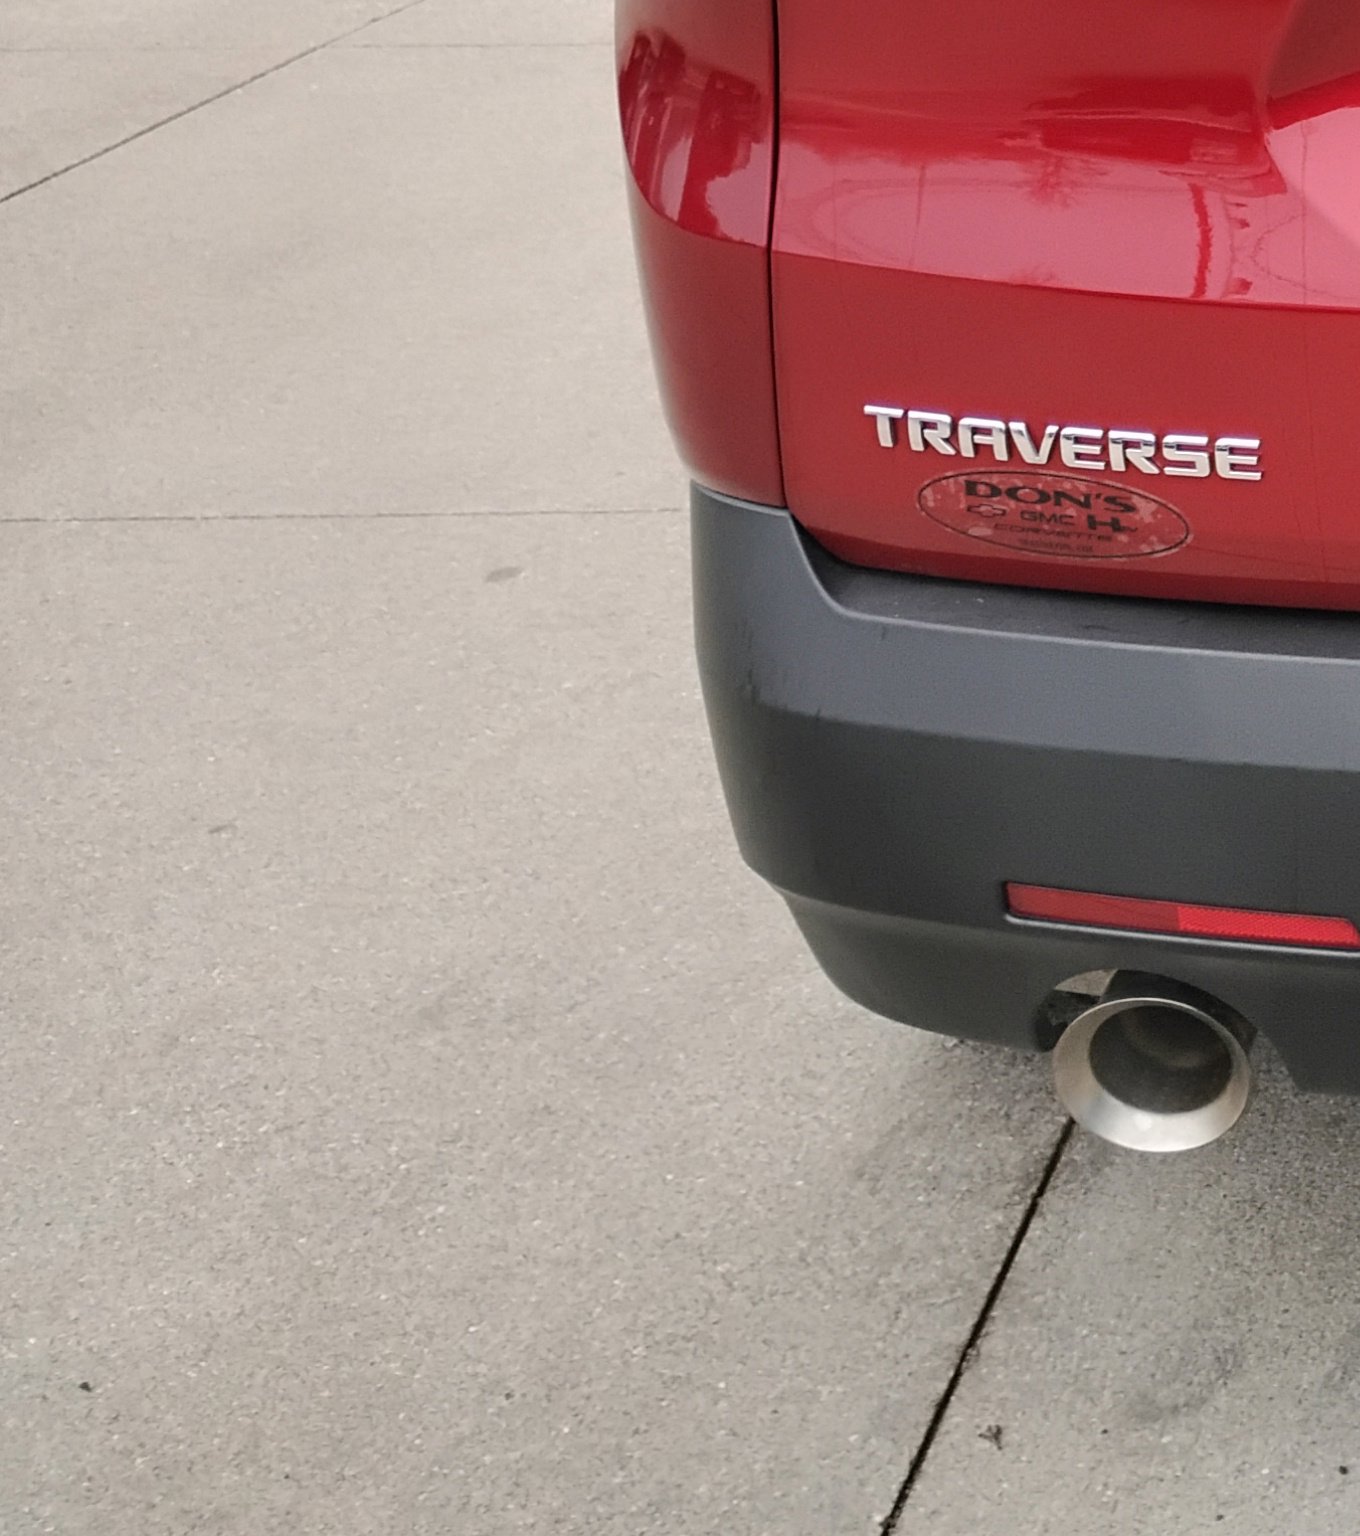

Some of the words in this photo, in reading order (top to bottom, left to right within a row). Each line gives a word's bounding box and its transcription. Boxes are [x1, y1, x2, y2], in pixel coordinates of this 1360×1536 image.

[863, 403, 1263, 482] TRAVERSE
[964, 479, 1137, 514] DON'S
[1019, 510, 1075, 527] GMC
